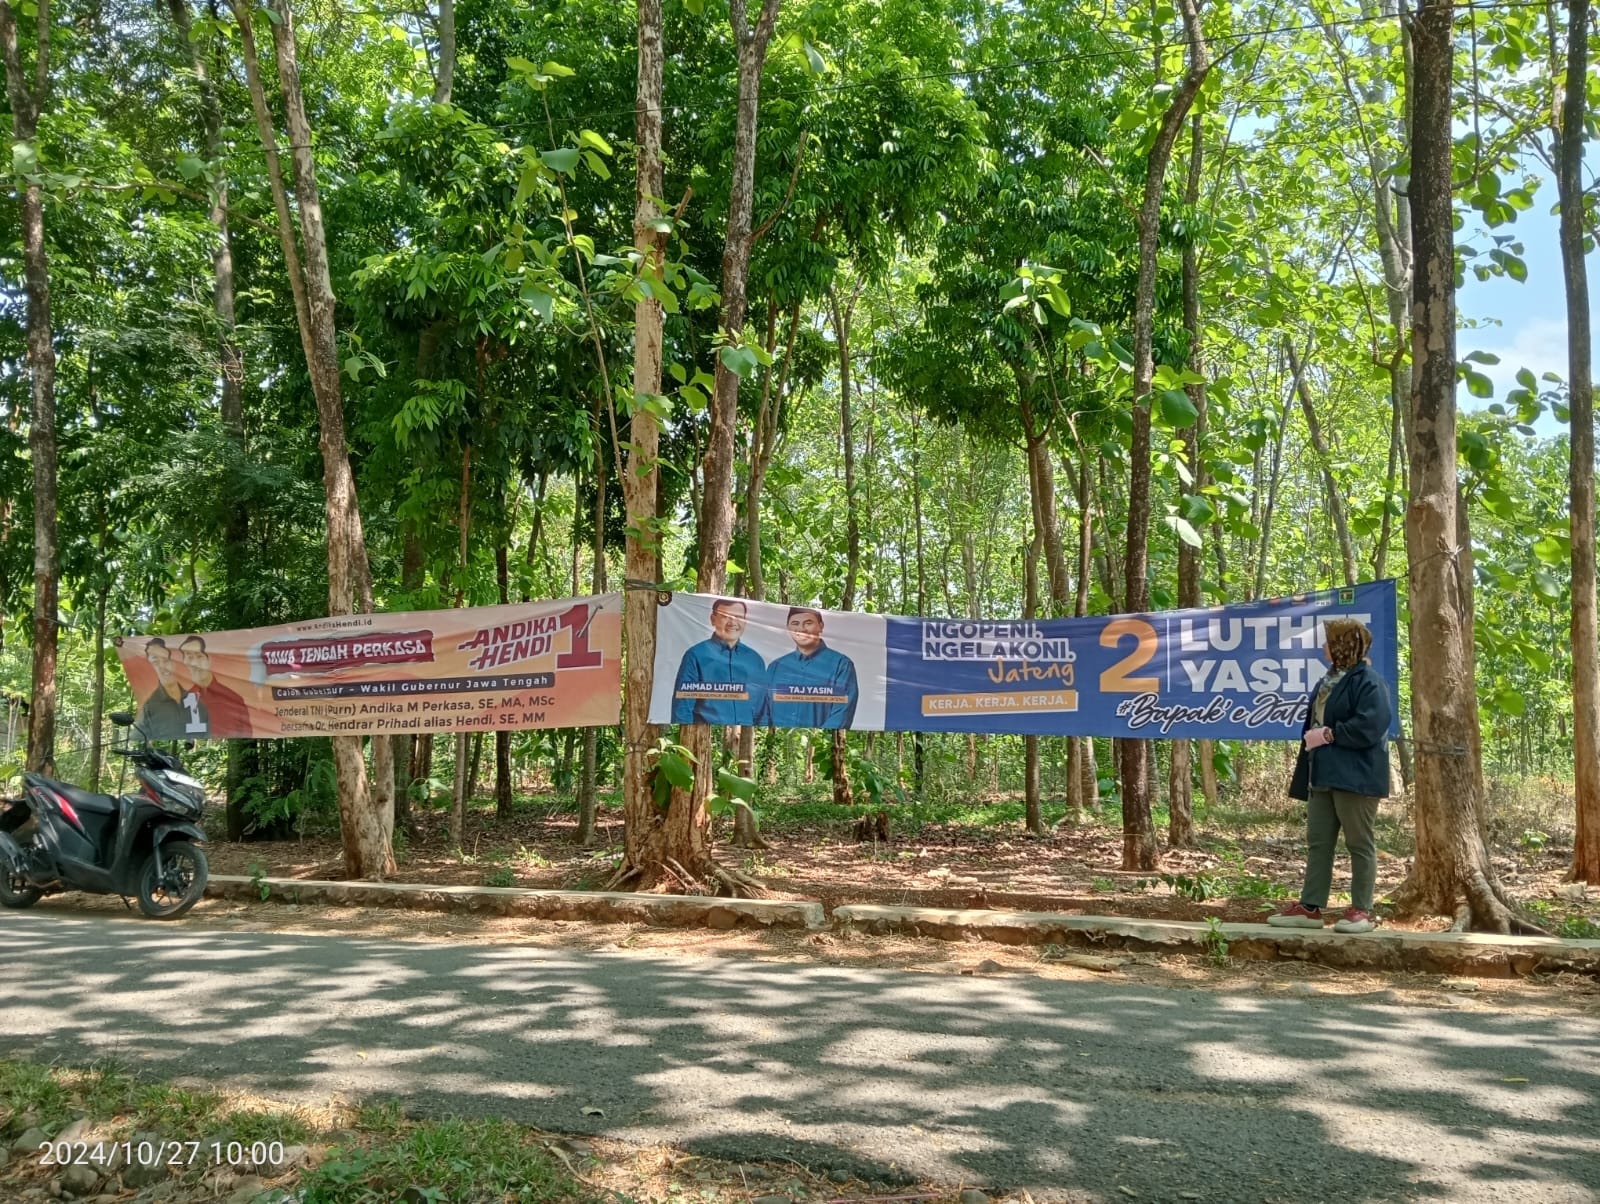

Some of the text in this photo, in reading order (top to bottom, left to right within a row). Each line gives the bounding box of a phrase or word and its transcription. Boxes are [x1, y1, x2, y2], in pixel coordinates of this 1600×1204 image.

[459, 616, 557, 650] ANDIKA
[557, 604, 602, 668] 1
[925, 622, 1041, 639] NGOPENI.
[1181, 613, 1371, 650] LUTHF
[265, 640, 426, 665] JAWA TENGAH PERKASA
[469, 635, 552, 670] HENDI
[925, 641, 1075, 659] NGELAKONI.
[1099, 619, 1160, 692] 2
[988, 656, 1074, 686] Jateng
[277, 688, 300, 697] Calon
[360, 684, 396, 693] Wakil
[402, 681, 460, 691] Gubernur
[466, 680, 497, 689] Jawa
[502, 676, 548, 688] Tengah
[681, 683, 744, 692] AHMAD LUTHFI
[789, 686, 806, 694] TAJ
[183, 692, 207, 733] 1
[274, 695, 555, 717] Jenderal TNI (Purn) Andika M Perkasa, SE, MA, MSc
[929, 694, 1068, 710] KERJA. KERJA. KERJA.
[1248, 693, 1308, 727] Jate
[329, 719, 373, 730] Hendrar
[376, 717, 421, 729] Prihadi
[424, 715, 452, 727] alias
[456, 714, 495, 727] Hendi,
[499, 713, 518, 725] SE,
[522, 712, 545, 723] MM
